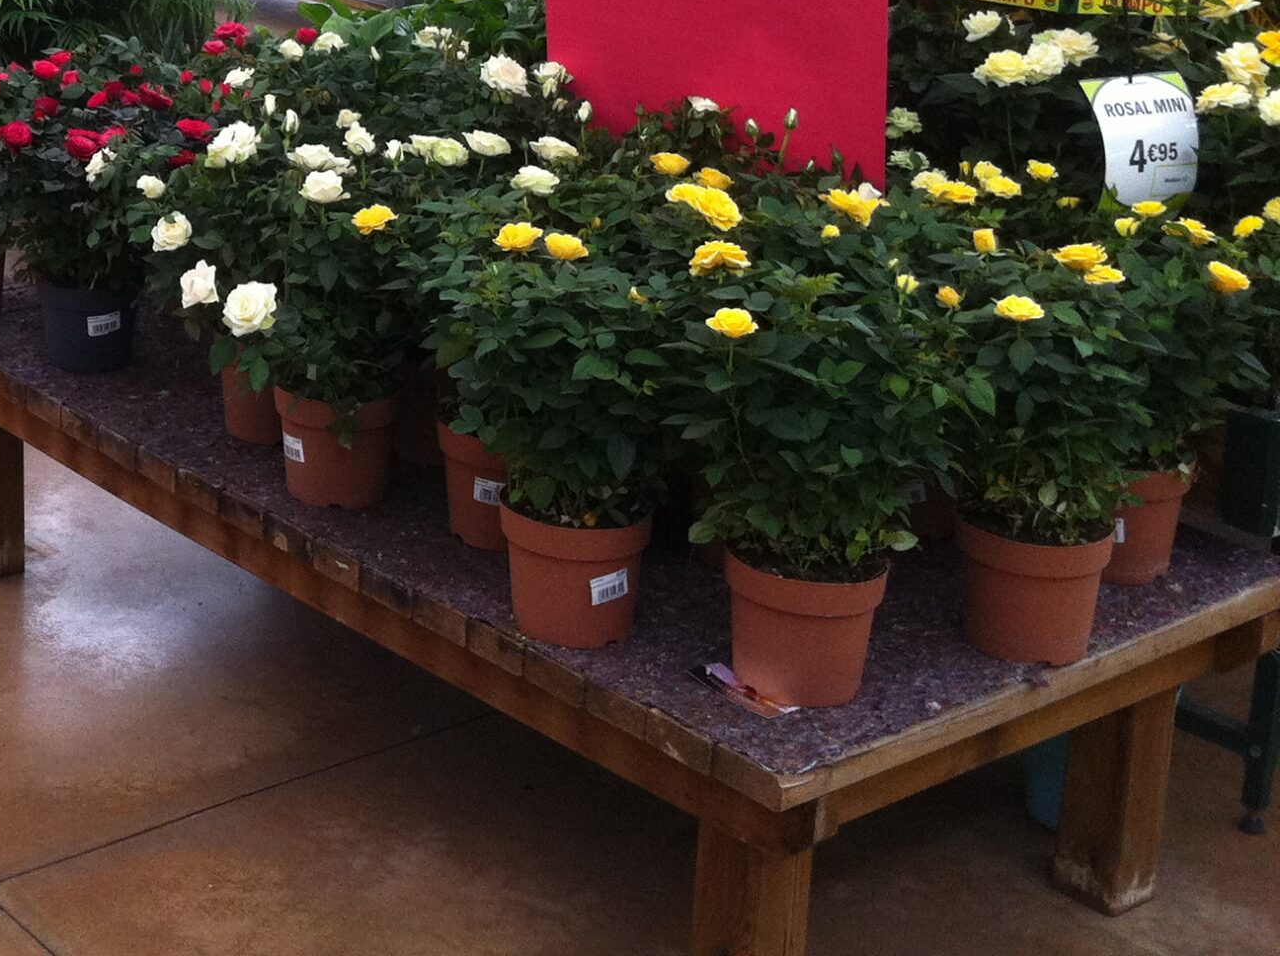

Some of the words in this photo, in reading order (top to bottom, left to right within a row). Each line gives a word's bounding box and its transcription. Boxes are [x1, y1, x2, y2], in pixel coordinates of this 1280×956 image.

[1104, 100, 1152, 117] ROSAL
[1153, 97, 1187, 113] MINI
[1129, 139, 1178, 173] 4€95
